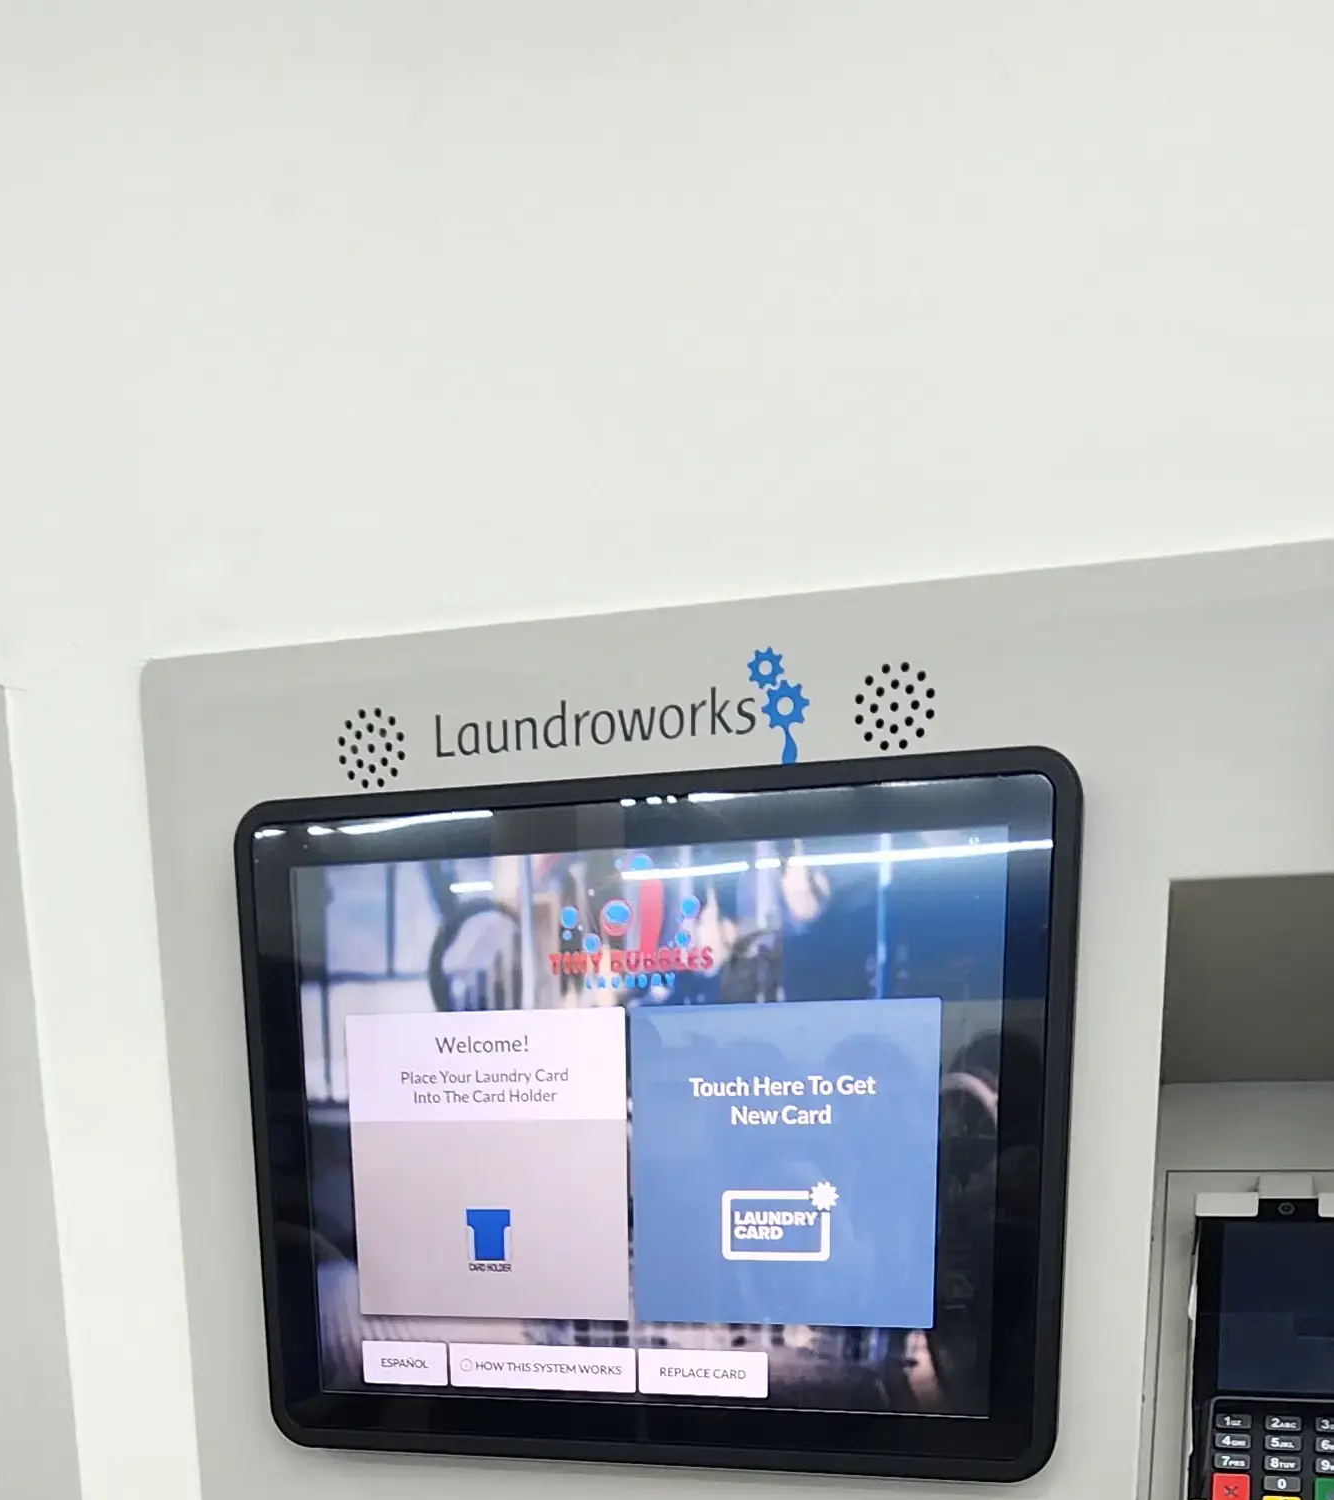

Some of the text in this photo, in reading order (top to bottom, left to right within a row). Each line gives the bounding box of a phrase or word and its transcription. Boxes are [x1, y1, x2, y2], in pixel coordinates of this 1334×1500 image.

[435, 686, 756, 757] Laundroworks
[435, 1035, 528, 1053] Welcome!
[401, 1068, 569, 1085] Place Your Laundry Card
[688, 1075, 877, 1097] Touch Here To Get
[413, 1089, 557, 1104] Into The Card Holder
[731, 1104, 832, 1126] New Card
[733, 1211, 818, 1226] LAUNDRY
[733, 1226, 784, 1240] CARD
[381, 1357, 429, 1371] ESPAÑOL
[475, 1360, 623, 1376] HOW THIS SYSTEM WORKS
[659, 1366, 747, 1381] REPLACE CARD
